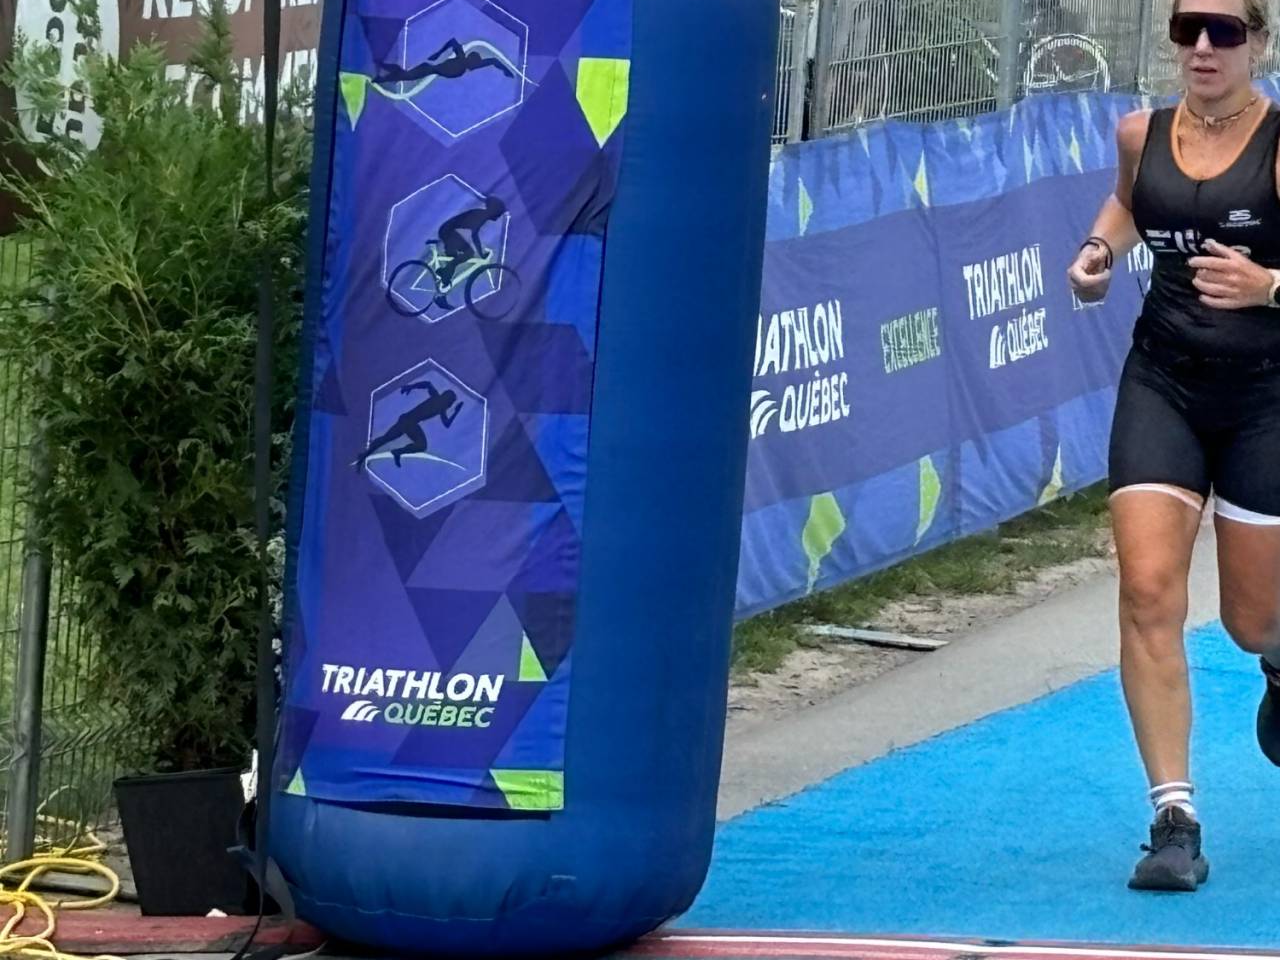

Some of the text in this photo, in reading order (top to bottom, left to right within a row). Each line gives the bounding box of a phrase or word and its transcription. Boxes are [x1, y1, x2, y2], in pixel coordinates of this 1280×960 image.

[962, 243, 1044, 321] TRIATHLON
[752, 298, 845, 377] IATHLON
[779, 370, 850, 433] QUÉBEC
[321, 663, 505, 702] TRIATHLON
[383, 700, 496, 728] QUÉBEC
